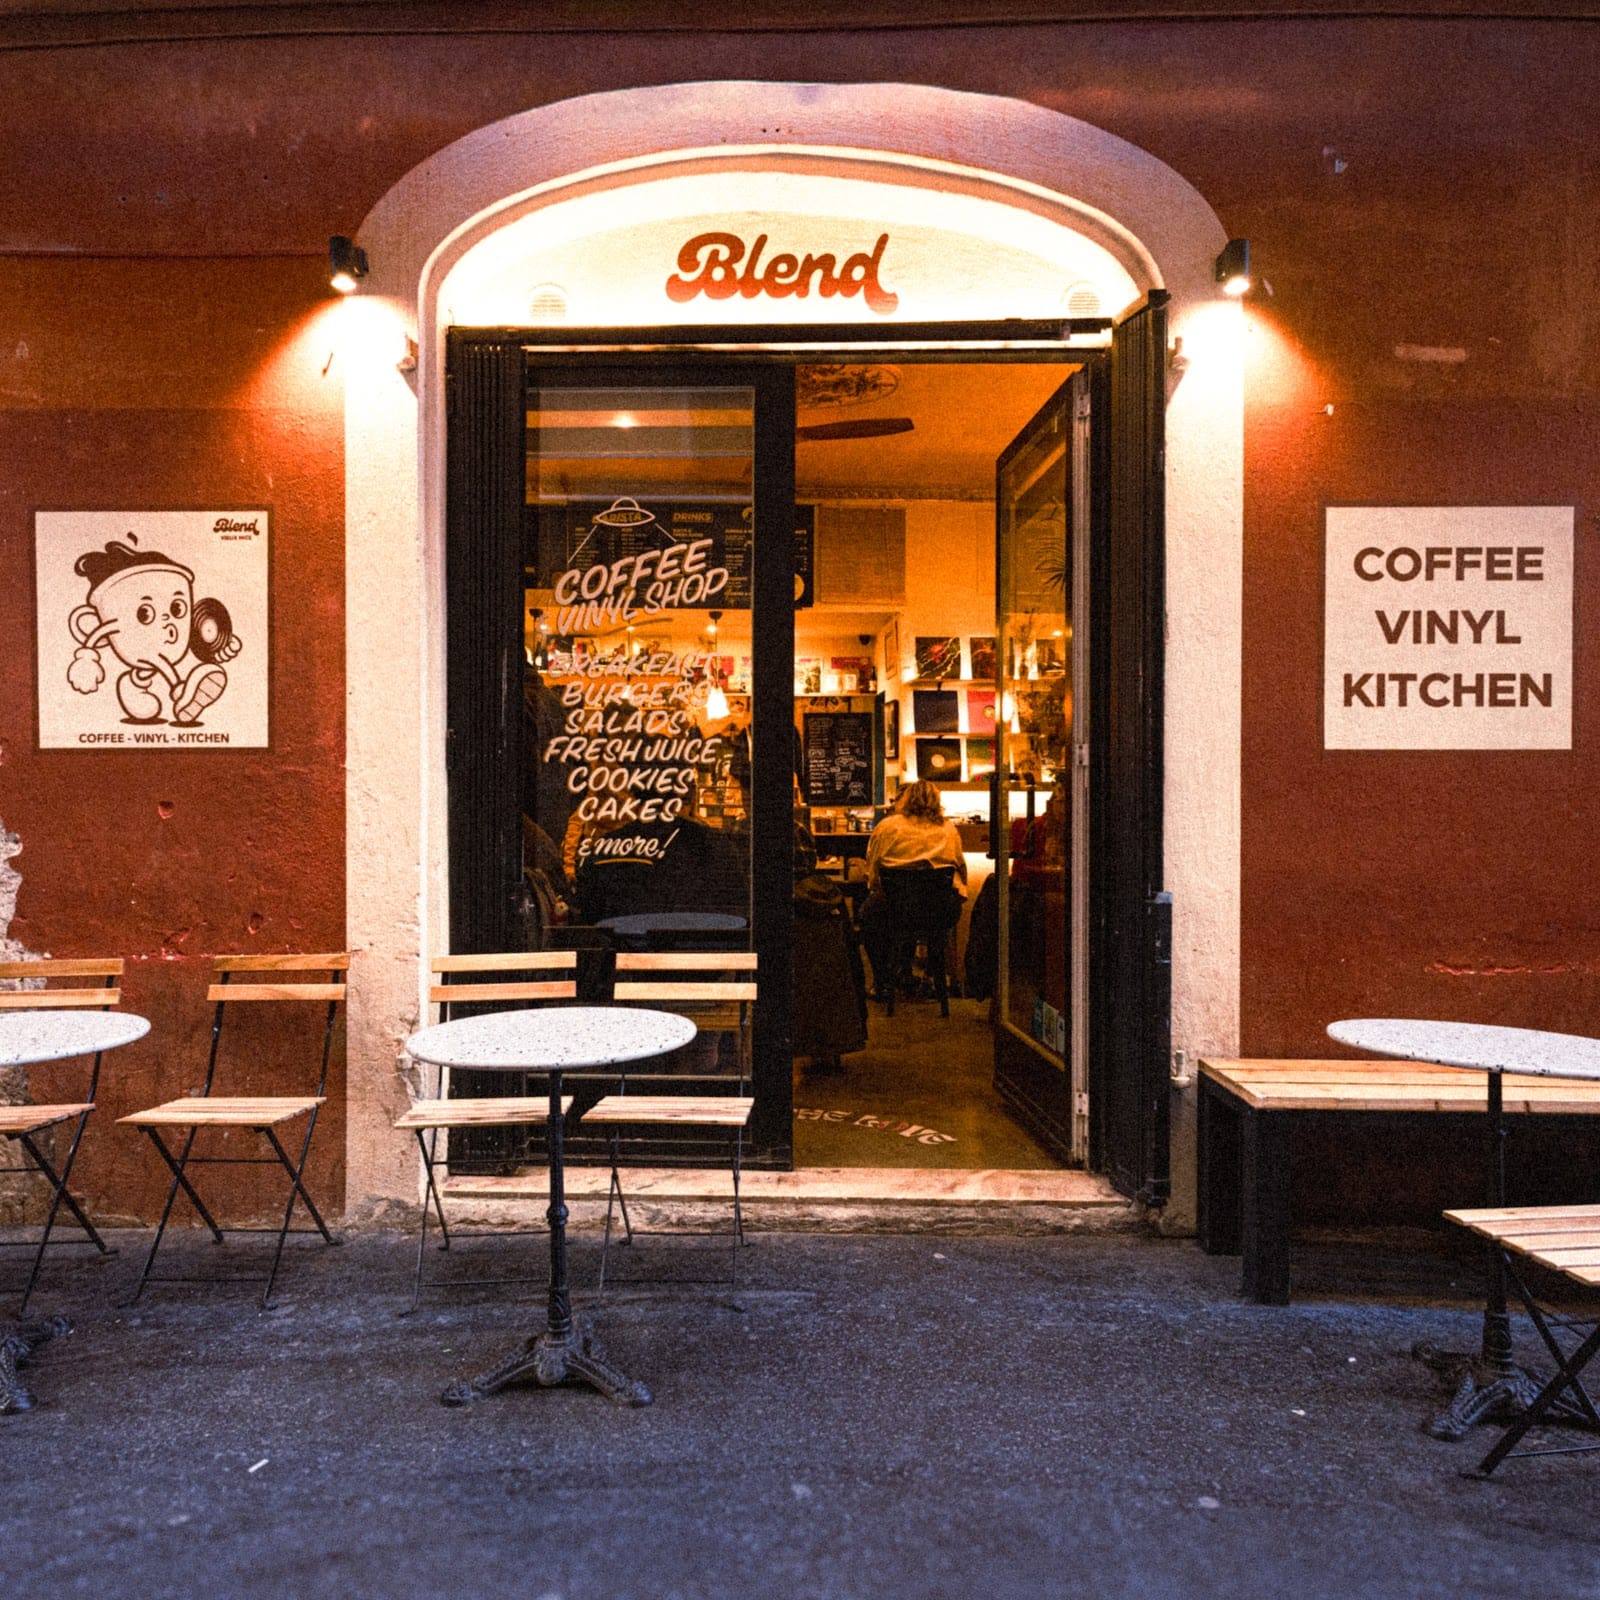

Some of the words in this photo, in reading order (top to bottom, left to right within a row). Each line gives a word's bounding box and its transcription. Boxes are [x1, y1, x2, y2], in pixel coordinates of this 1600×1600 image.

[665, 231, 899, 315] Blend
[213, 518, 260, 536] Blend
[672, 512, 713, 522] DRINKS
[554, 539, 714, 606] COFFEE
[1353, 546, 1544, 582] COFFEE
[557, 588, 638, 637] VINYL
[643, 567, 729, 616] SHOP
[1374, 609, 1522, 645] VINYL
[549, 652, 724, 679] BREAKFAST
[561, 680, 711, 707] BURGERS
[1343, 672, 1553, 708] KITCHEN
[78, 733, 125, 744] COFFEE
[134, 733, 169, 744] VINYL
[177, 733, 230, 744] KITCHEN
[544, 736, 644, 763] FRESH
[643, 738, 722, 764] JUICE
[567, 766, 696, 794] COOKIES
[578, 797, 683, 822] CAKES
